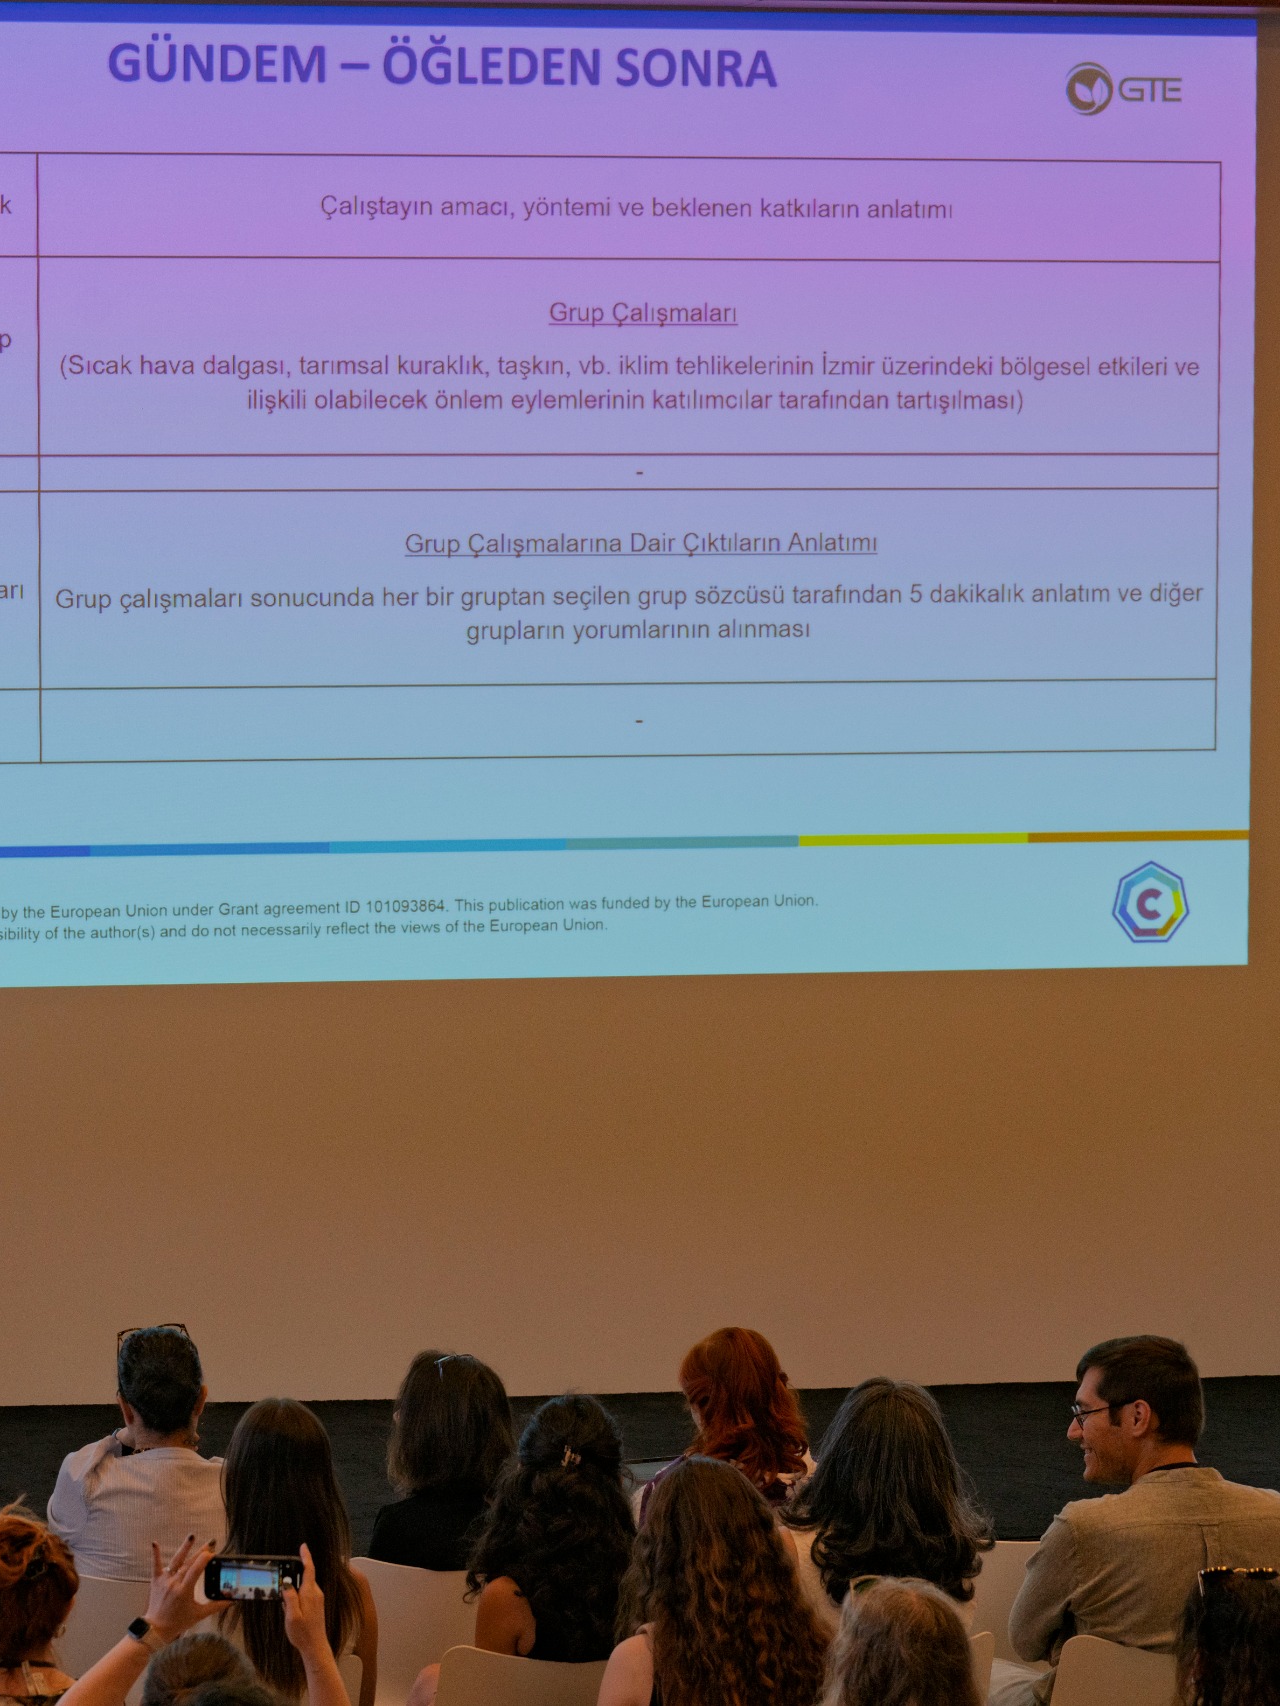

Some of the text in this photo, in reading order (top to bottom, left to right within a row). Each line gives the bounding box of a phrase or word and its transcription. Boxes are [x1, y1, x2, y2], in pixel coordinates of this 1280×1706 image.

[107, 33, 327, 85] GÜNDEM
[382, 34, 601, 87] ÖĞLEDEN
[615, 47, 779, 89] SONRA
[1117, 75, 1183, 103] GTE
[318, 193, 954, 222] Çalıştayın amacı, yöntemi ve beklenen katkıların anlatımı
[548, 300, 737, 328] Grup Çalışmaları
[59, 350, 1200, 382] (Sıcak hava dalgası, tarımsal kuraklık, taşkın, vb. iklim tehlikelerinin İzmir üzerindeki bölgesel etkileri ve
[246, 388, 1024, 416] ilişkili olabilecek önlem eylemlerinin katılımcılar tarafından tartışılması)
[404, 530, 878, 560] Grup Çalışmalarına Dair Çıktıların Anlatımı
[54, 581, 1204, 615] Grup çalışmaları sonucunda her bir gruptan seçilen grup sözcüsü tarafından 5 dakikalık anlatım ve diğer
[465, 618, 811, 647] grupların yorumlarının alınması
[0, 906, 19, 923] by
[22, 905, 46, 920] the
[49, 904, 122, 922] European
[124, 903, 168, 919] Union
[171, 902, 214, 917] under
[218, 901, 260, 917] Grant
[262, 900, 341, 919] agreement
[344, 899, 362, 915] ID
[366, 898, 450, 914] 101093864.
[453, 897, 485, 913] This
[487, 897, 565, 915] publication
[568, 899, 598, 911] was
[600, 895, 651, 911] funded
[653, 895, 672, 913] by
[674, 895, 698, 909] the
[701, 893, 770, 911] European
[773, 893, 819, 908] Union.
[1136, 888, 1163, 921] C
[44, 925, 60, 941] of
[62, 925, 87, 940] the
[89, 924, 156, 941] author(s)
[159, 924, 188, 939] and
[190, 923, 211, 938] do
[212, 924, 237, 938] not
[240, 922, 322, 939] necessarily
[325, 920, 370, 936] reflect
[373, 920, 397, 935] the
[400, 922, 442, 935] views
[444, 919, 460, 934] of
[462, 919, 486, 934] the
[488, 918, 559, 935] European
[562, 917, 609, 932] Union.
